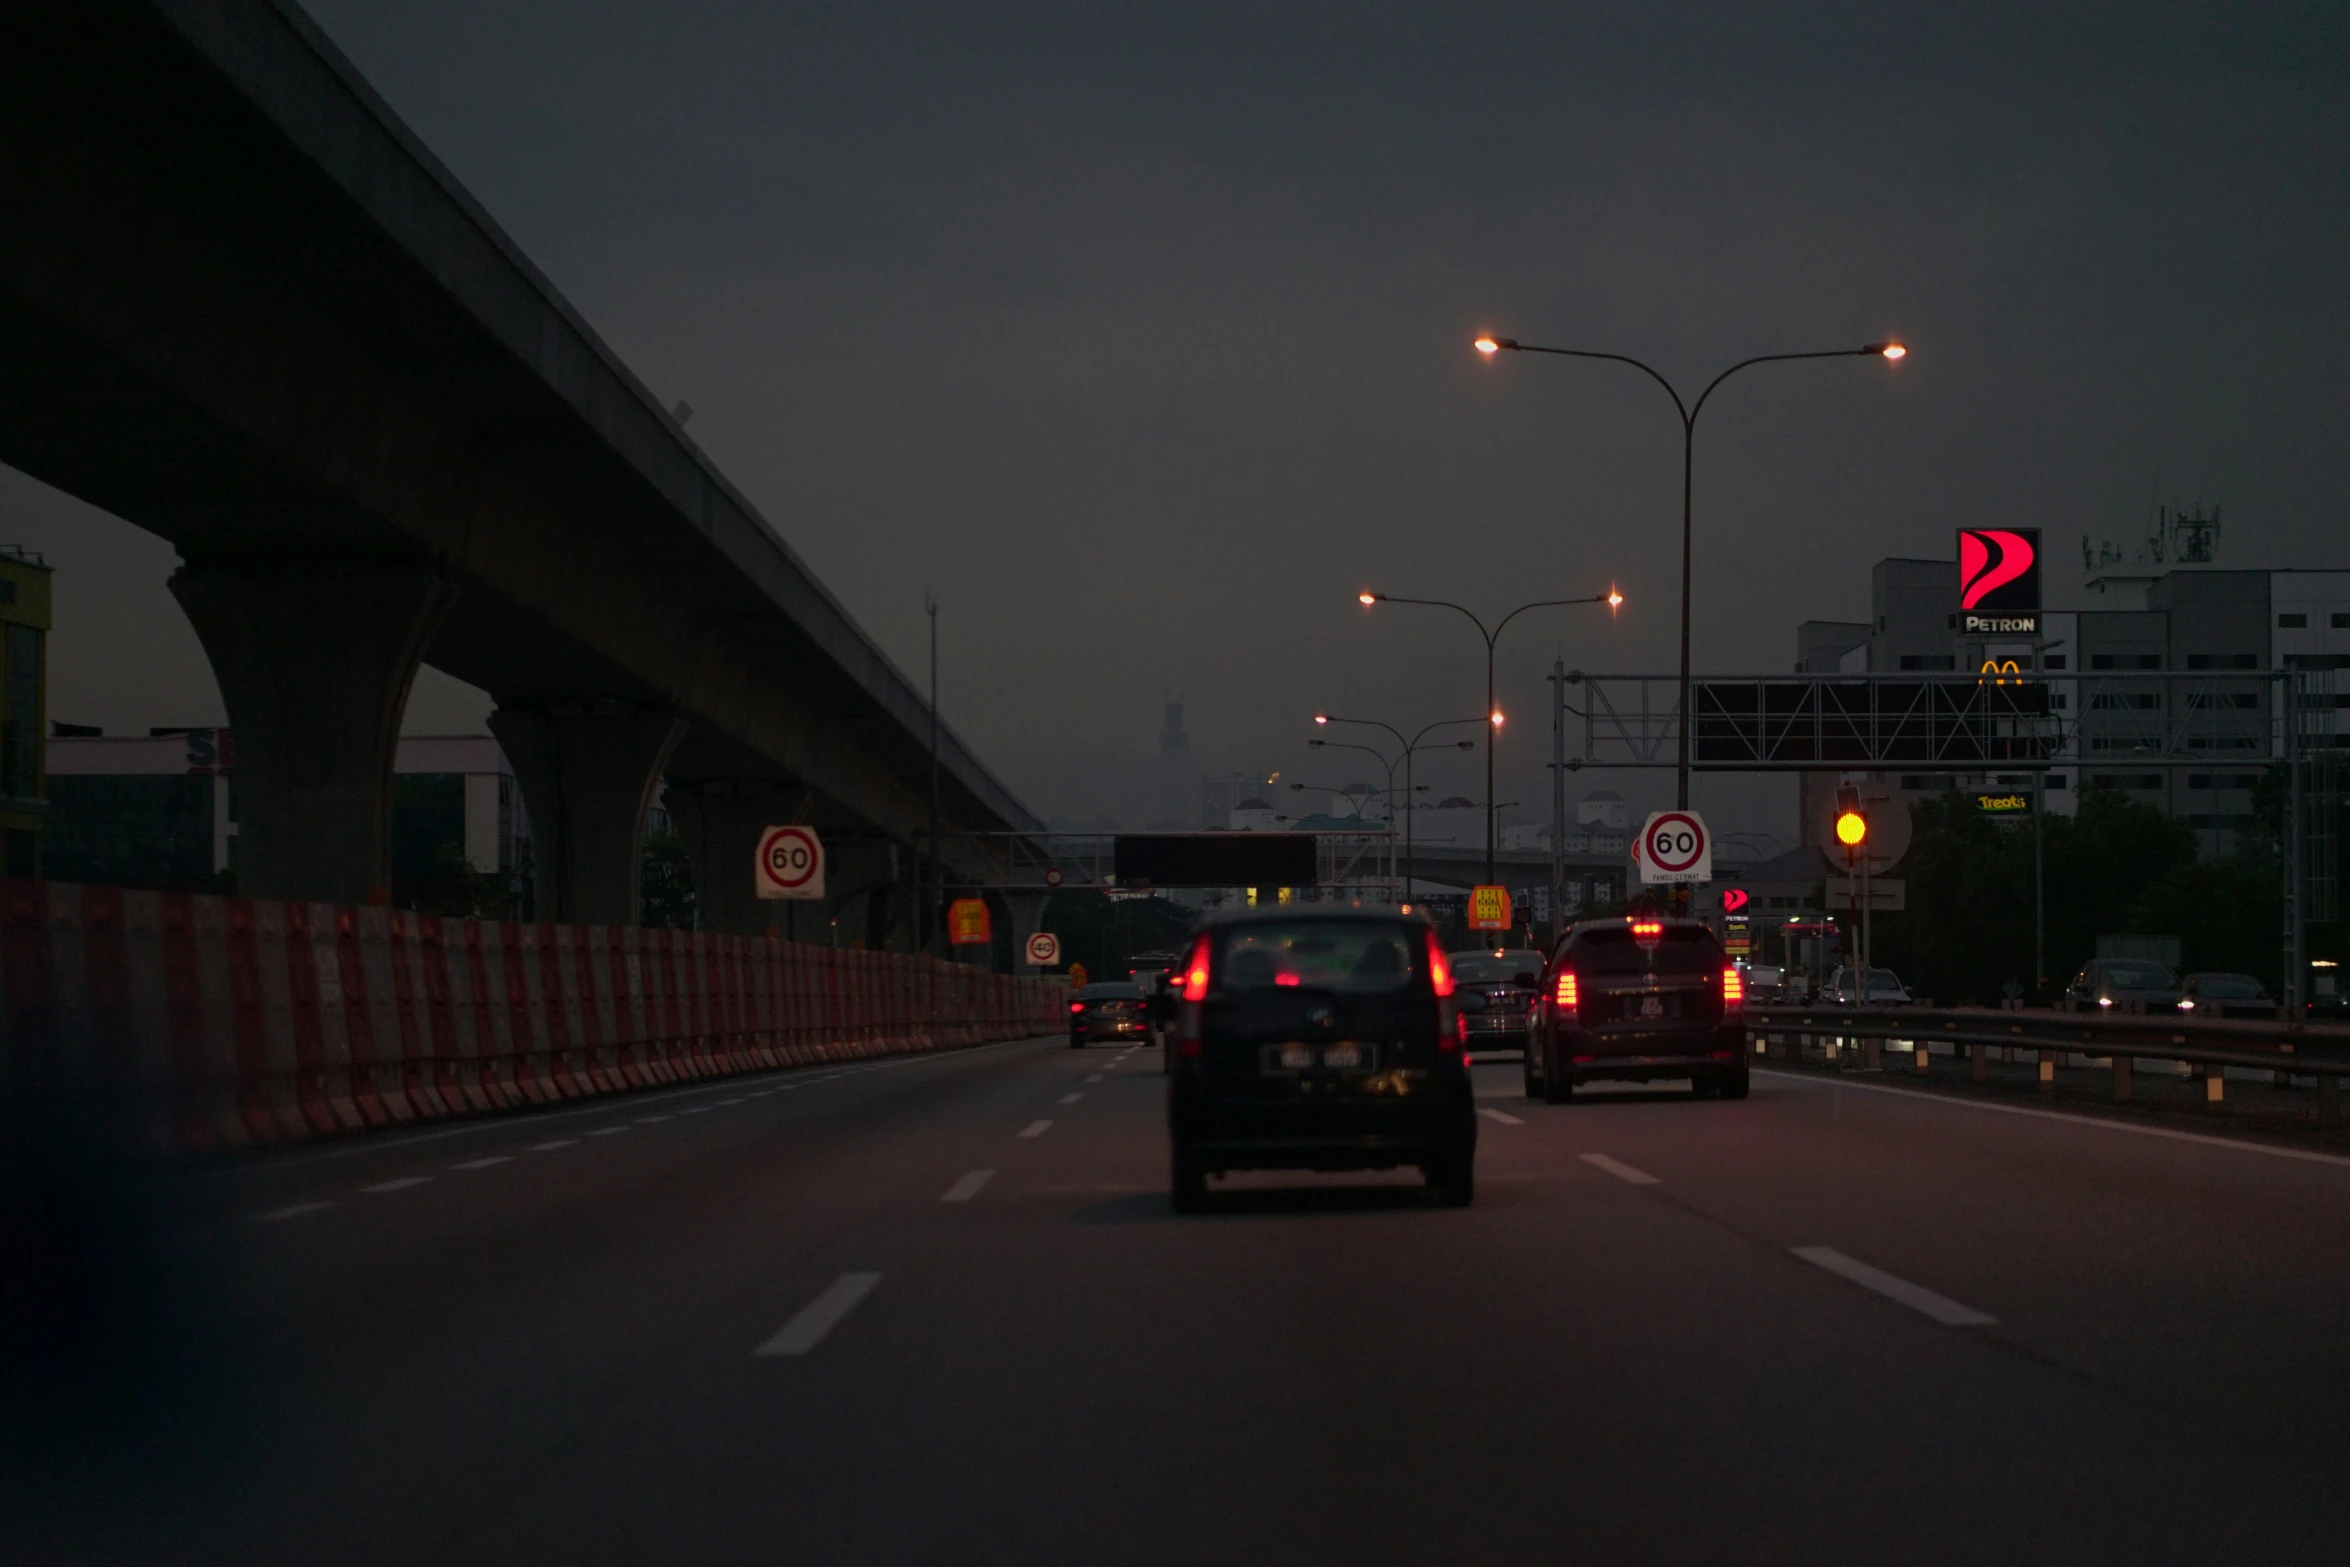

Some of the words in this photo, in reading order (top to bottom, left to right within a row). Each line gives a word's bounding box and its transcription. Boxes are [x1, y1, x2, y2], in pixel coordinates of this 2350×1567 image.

[1966, 616, 2035, 632] PETRON
[1978, 794, 2027, 809] Treats
[1656, 831, 1694, 854] 60
[772, 847, 808, 869] 60
[1652, 874, 1673, 882] PANDU
[1675, 873, 1700, 881] CERMAT
[1034, 942, 1051, 952] 40
